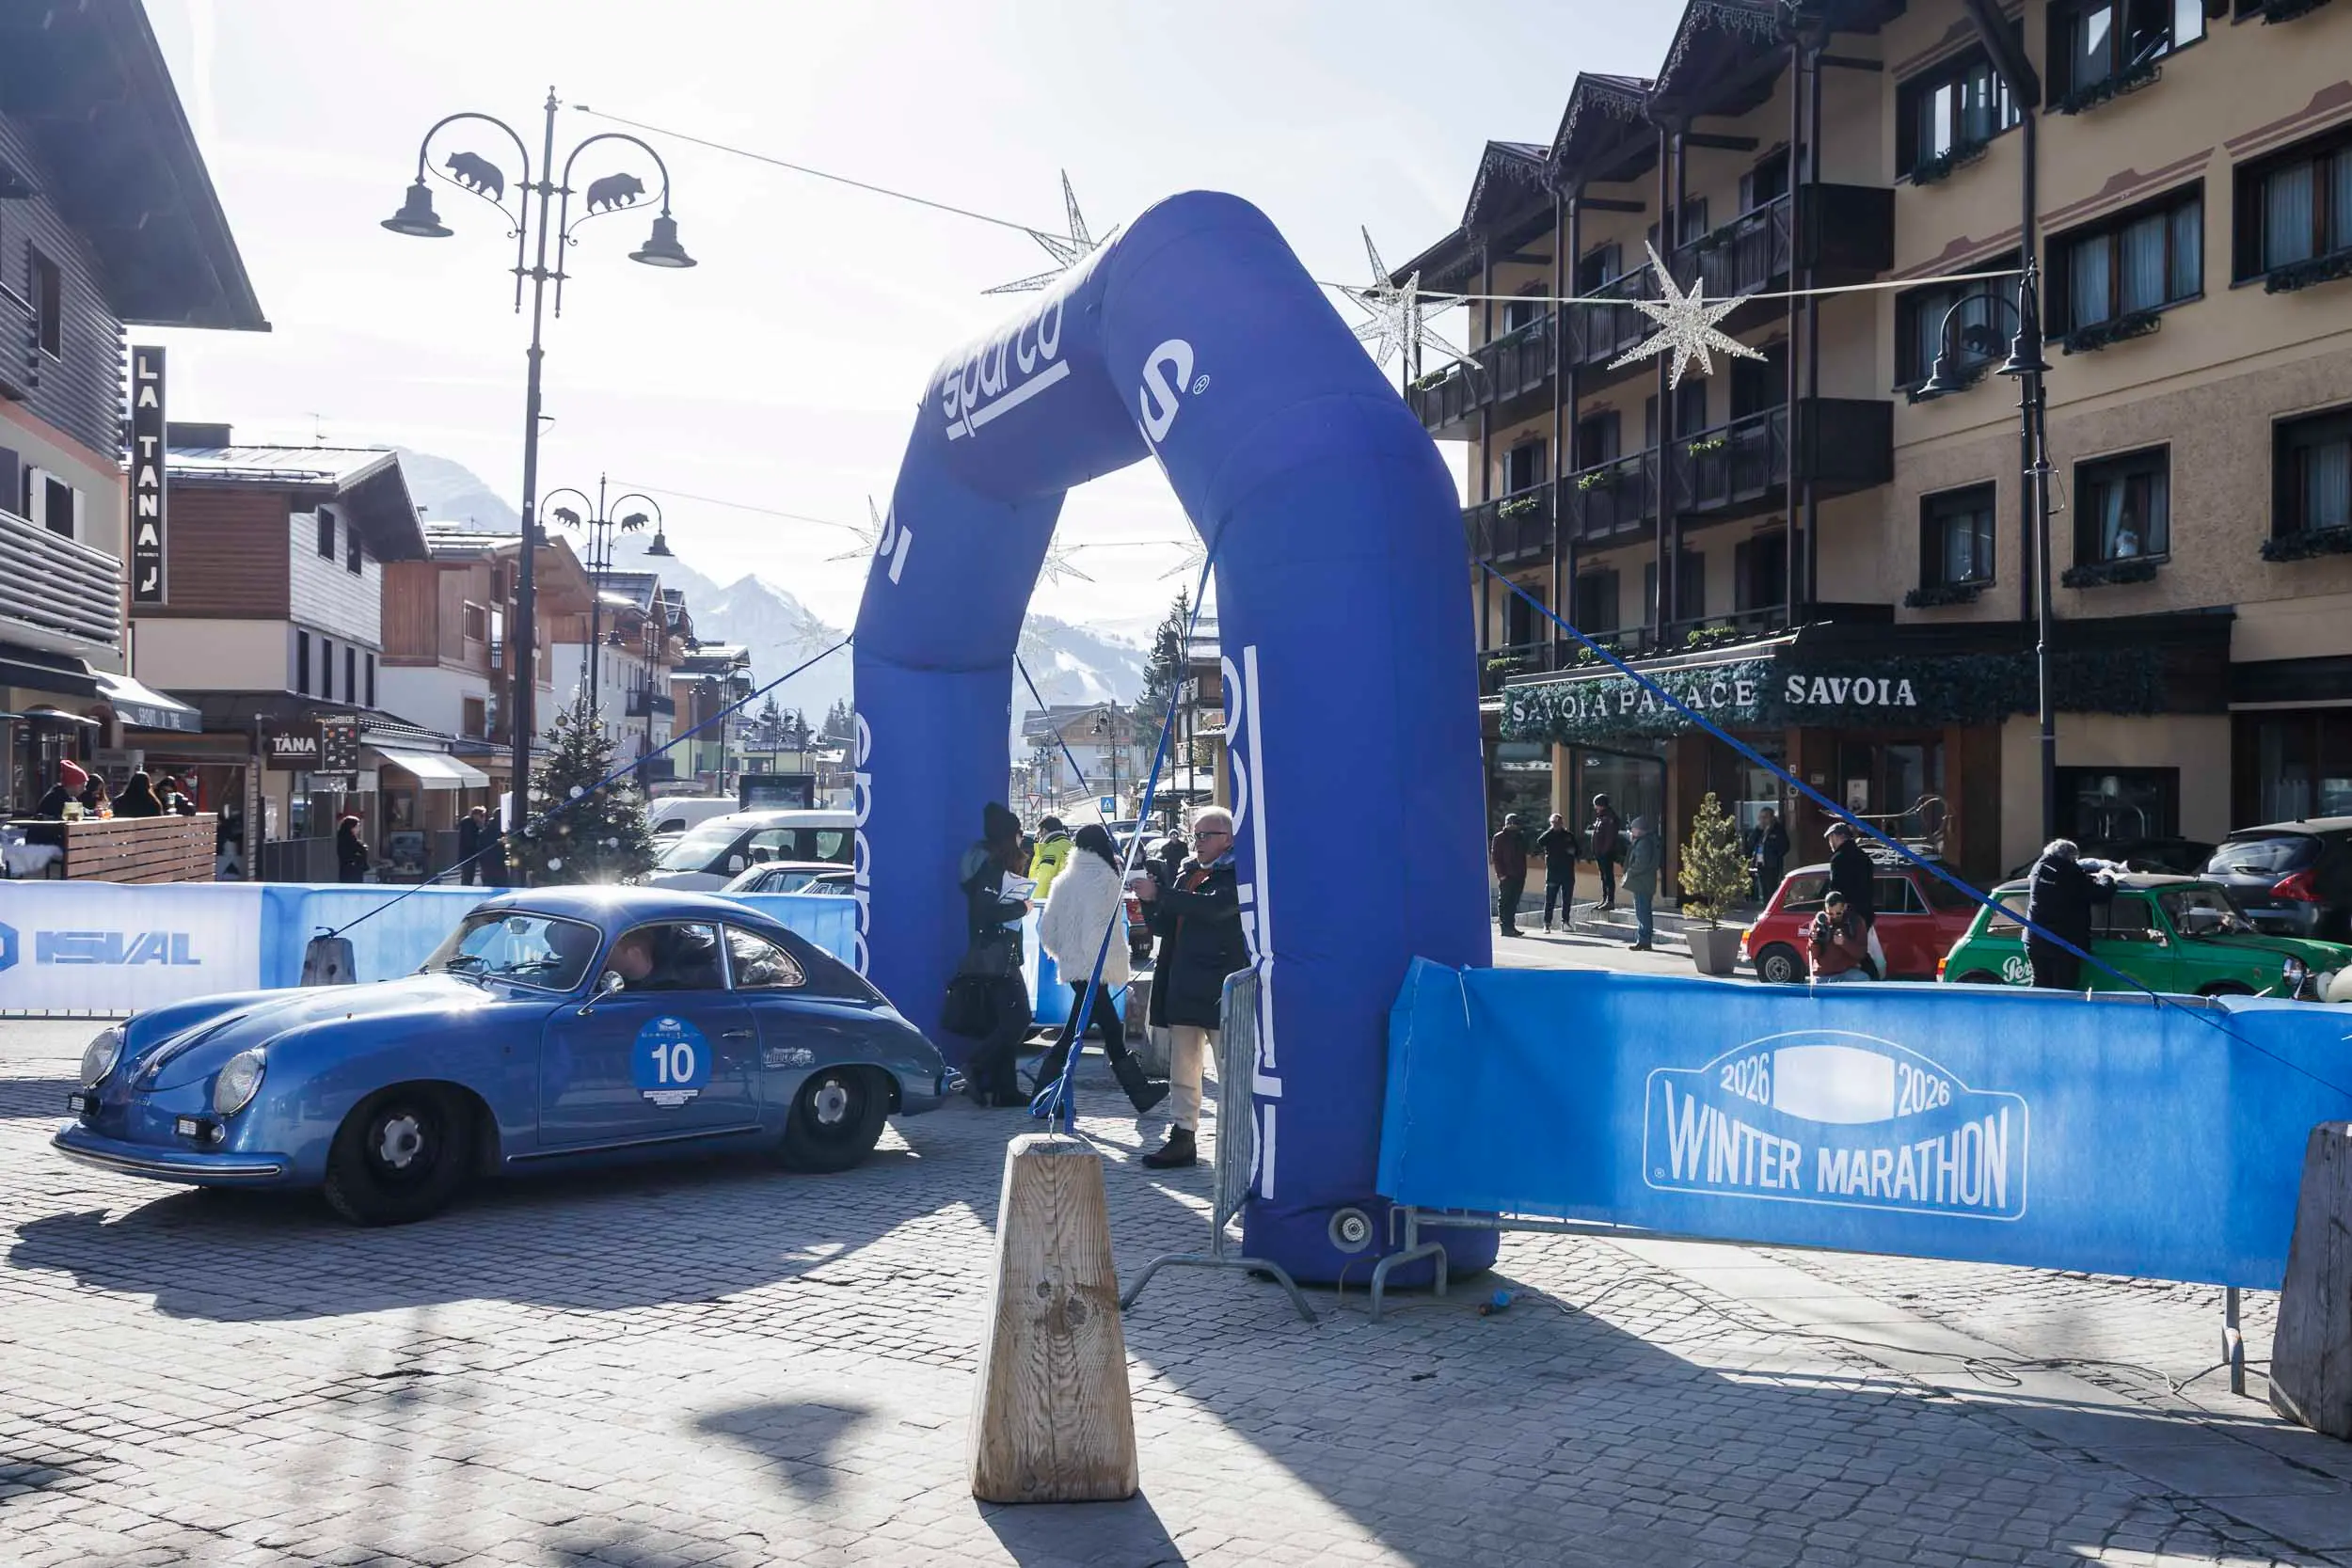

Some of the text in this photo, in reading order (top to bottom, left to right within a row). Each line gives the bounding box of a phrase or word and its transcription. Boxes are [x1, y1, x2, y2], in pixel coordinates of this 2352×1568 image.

[138, 356, 158, 408] LA
[138, 436, 158, 546] TANA
[1512, 679, 1756, 722] SAVOIA PALACE
[1785, 674, 1917, 706] SAVOIA
[272, 736, 317, 752] TANA
[651, 1042, 695, 1084] 10
[1720, 1052, 1951, 1117] 2026 2026
[1664, 1079, 2009, 1210] WINTER MARATHON
